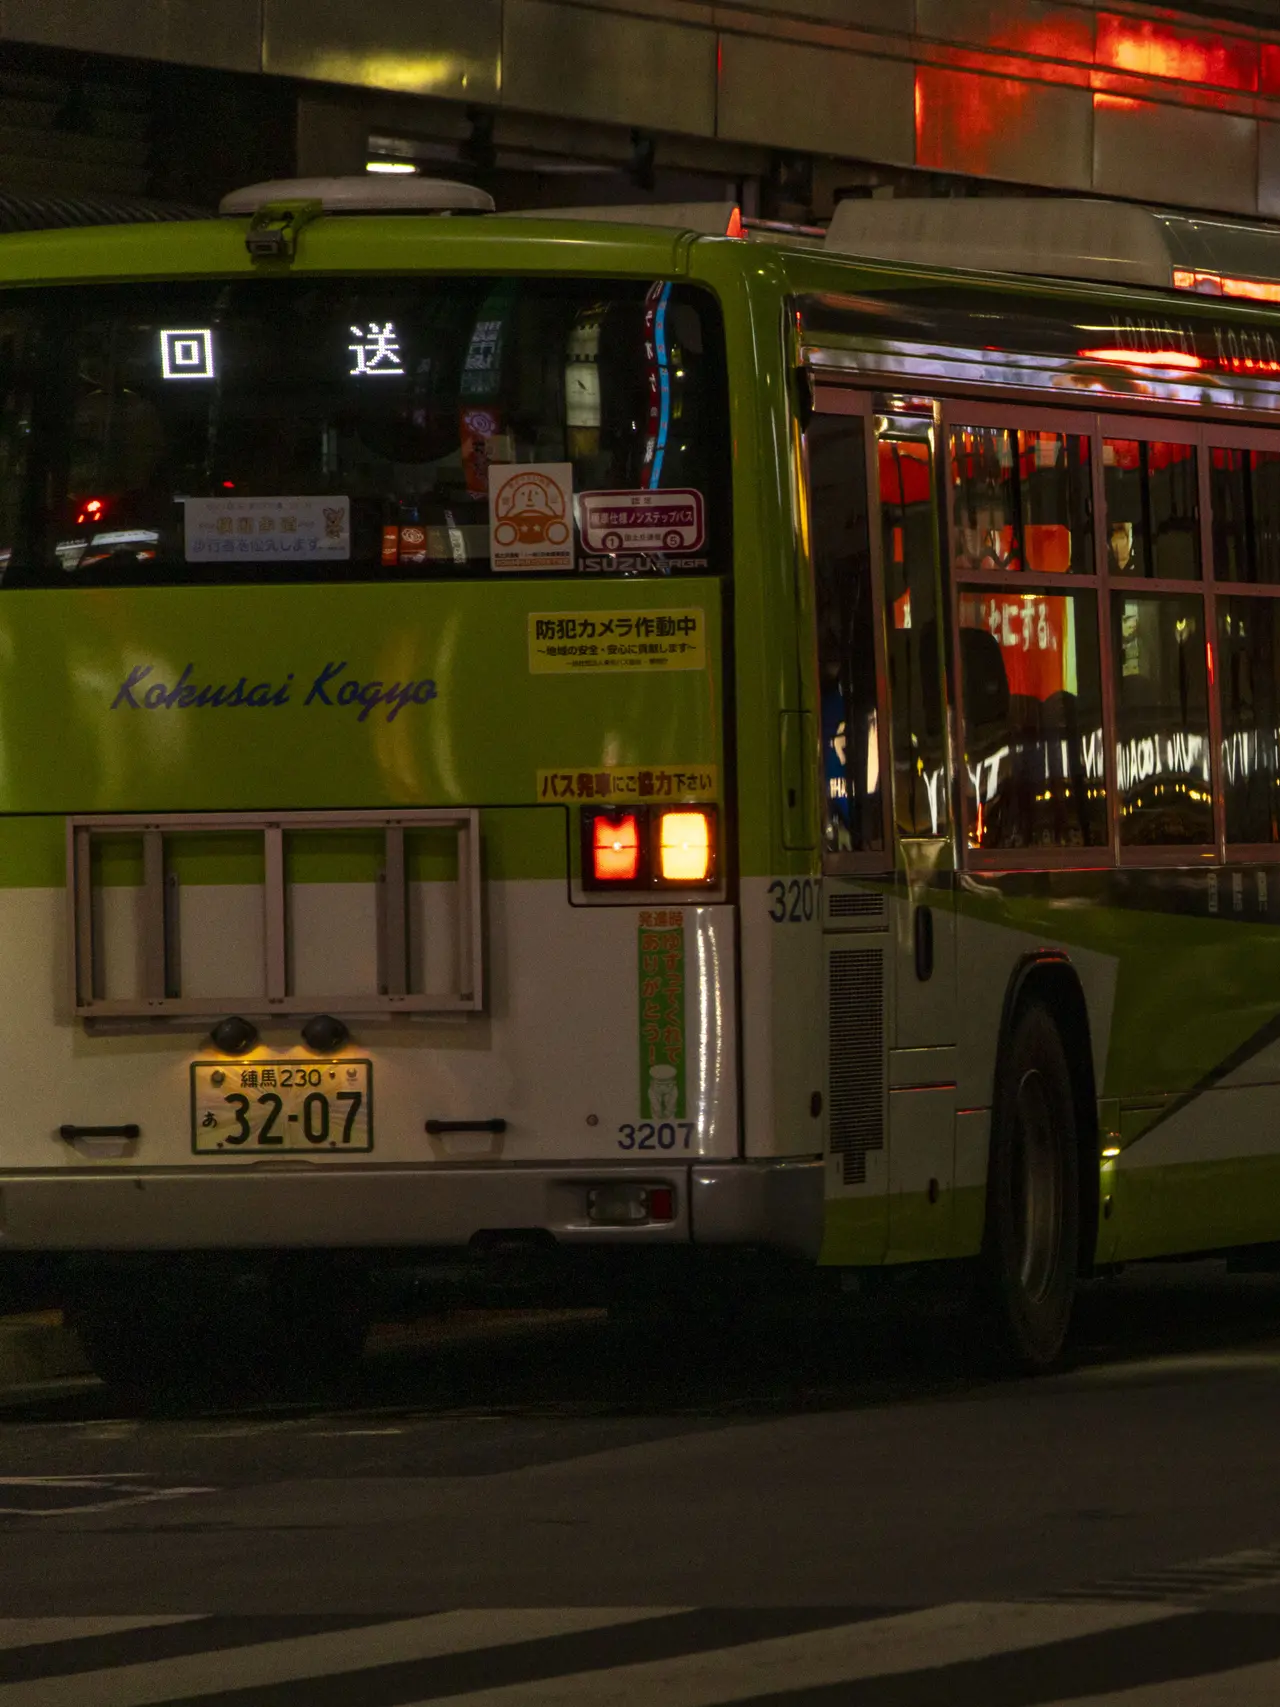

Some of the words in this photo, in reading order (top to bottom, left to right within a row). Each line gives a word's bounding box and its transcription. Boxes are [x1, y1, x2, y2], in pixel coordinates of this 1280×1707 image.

[578, 557, 650, 572] ISUZU
[535, 616, 697, 641] 防犯カメラ作動中
[110, 662, 294, 711] Kokusai
[303, 661, 438, 723] Kogyo
[542, 772, 712, 798] バス発車にご協力下さい
[202, 1112, 218, 1128] あ
[224, 1091, 362, 1145] 32-07
[618, 1123, 694, 1150] 3207
